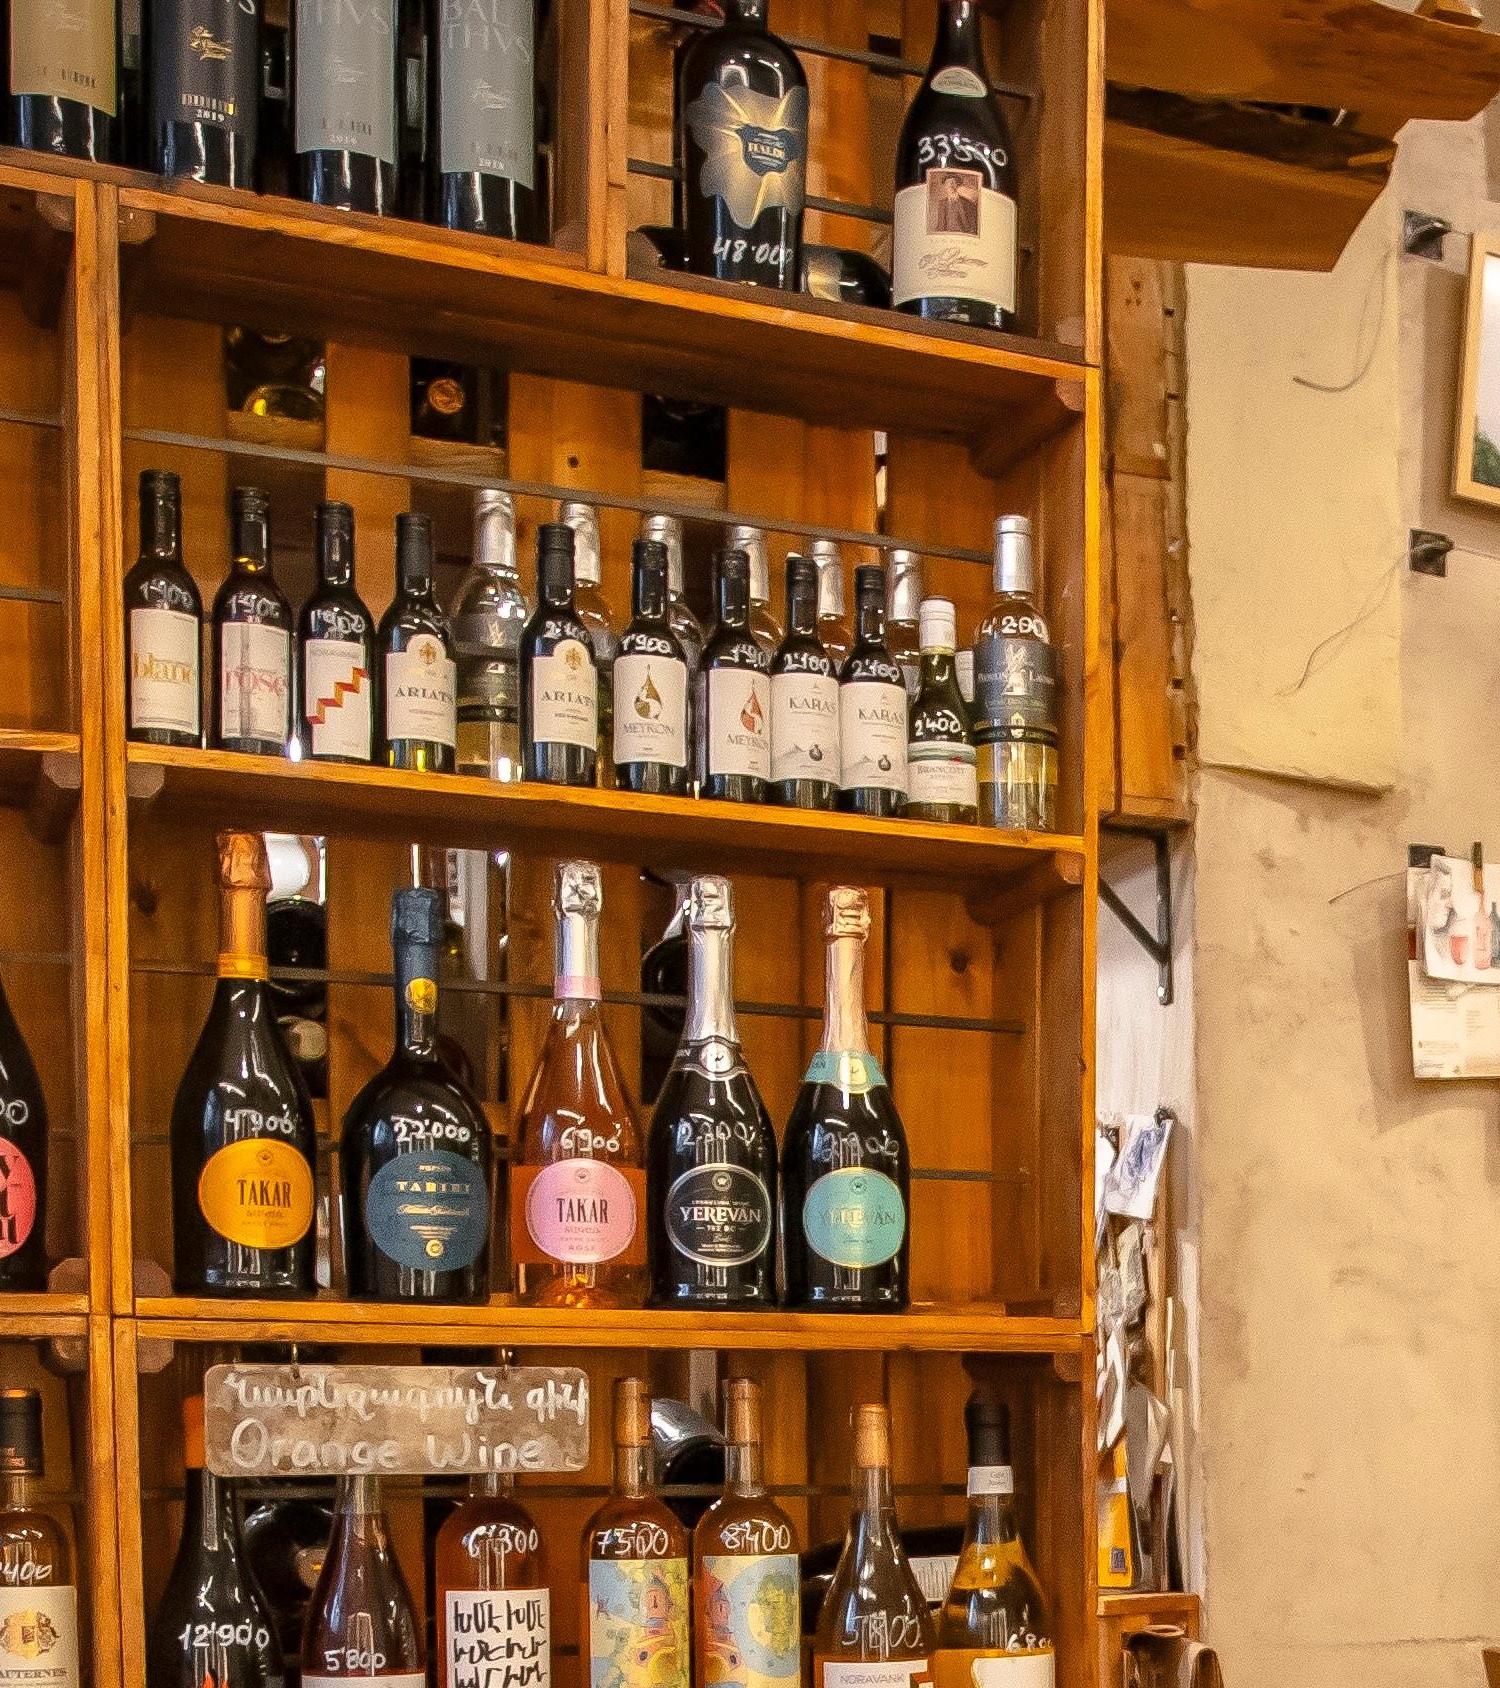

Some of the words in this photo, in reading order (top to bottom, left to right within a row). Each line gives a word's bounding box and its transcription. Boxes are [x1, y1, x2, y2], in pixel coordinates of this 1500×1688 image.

[237, 1179, 293, 1208] TAKAR
[556, 1197, 609, 1225] TAKAR
[679, 1206, 762, 1224] YEREVAN
[231, 1417, 402, 1474] Orange
[424, 1431, 548, 1469] Wine
[839, 1672, 907, 1687] NORAVANK
